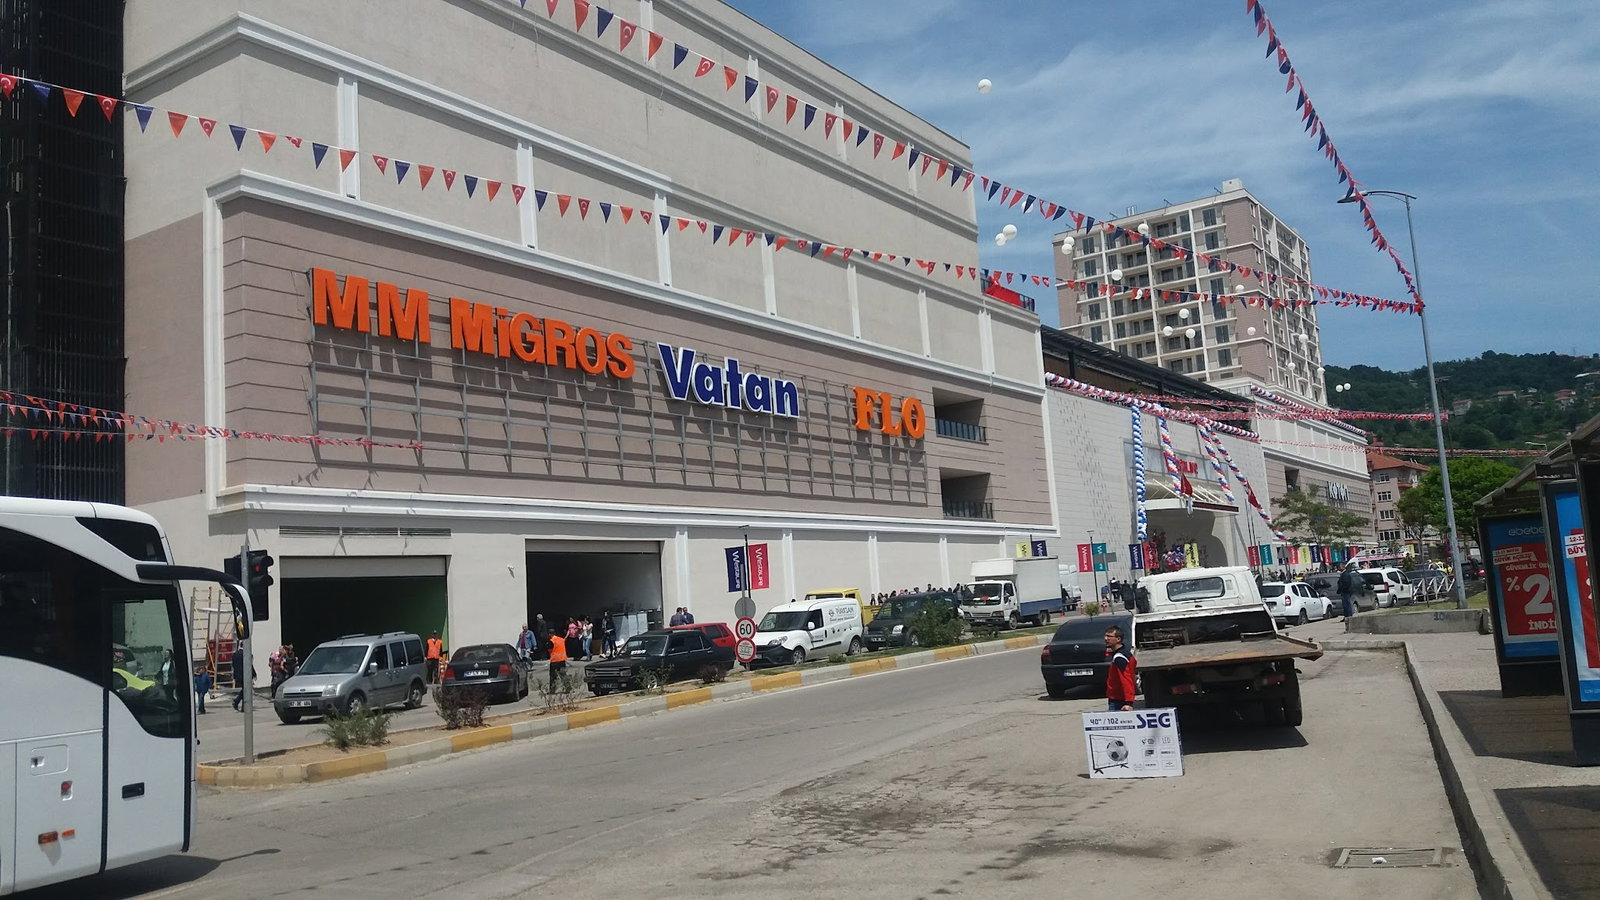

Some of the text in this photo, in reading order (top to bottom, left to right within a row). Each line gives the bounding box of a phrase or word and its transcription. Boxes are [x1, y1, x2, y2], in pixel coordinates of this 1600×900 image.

[313, 268, 431, 345] MM
[656, 342, 799, 418] Vatan
[852, 386, 926, 440] FLO
[740, 623, 752, 635] 60
[1107, 717, 1119, 725] 102
[1136, 712, 1171, 729] SEG
